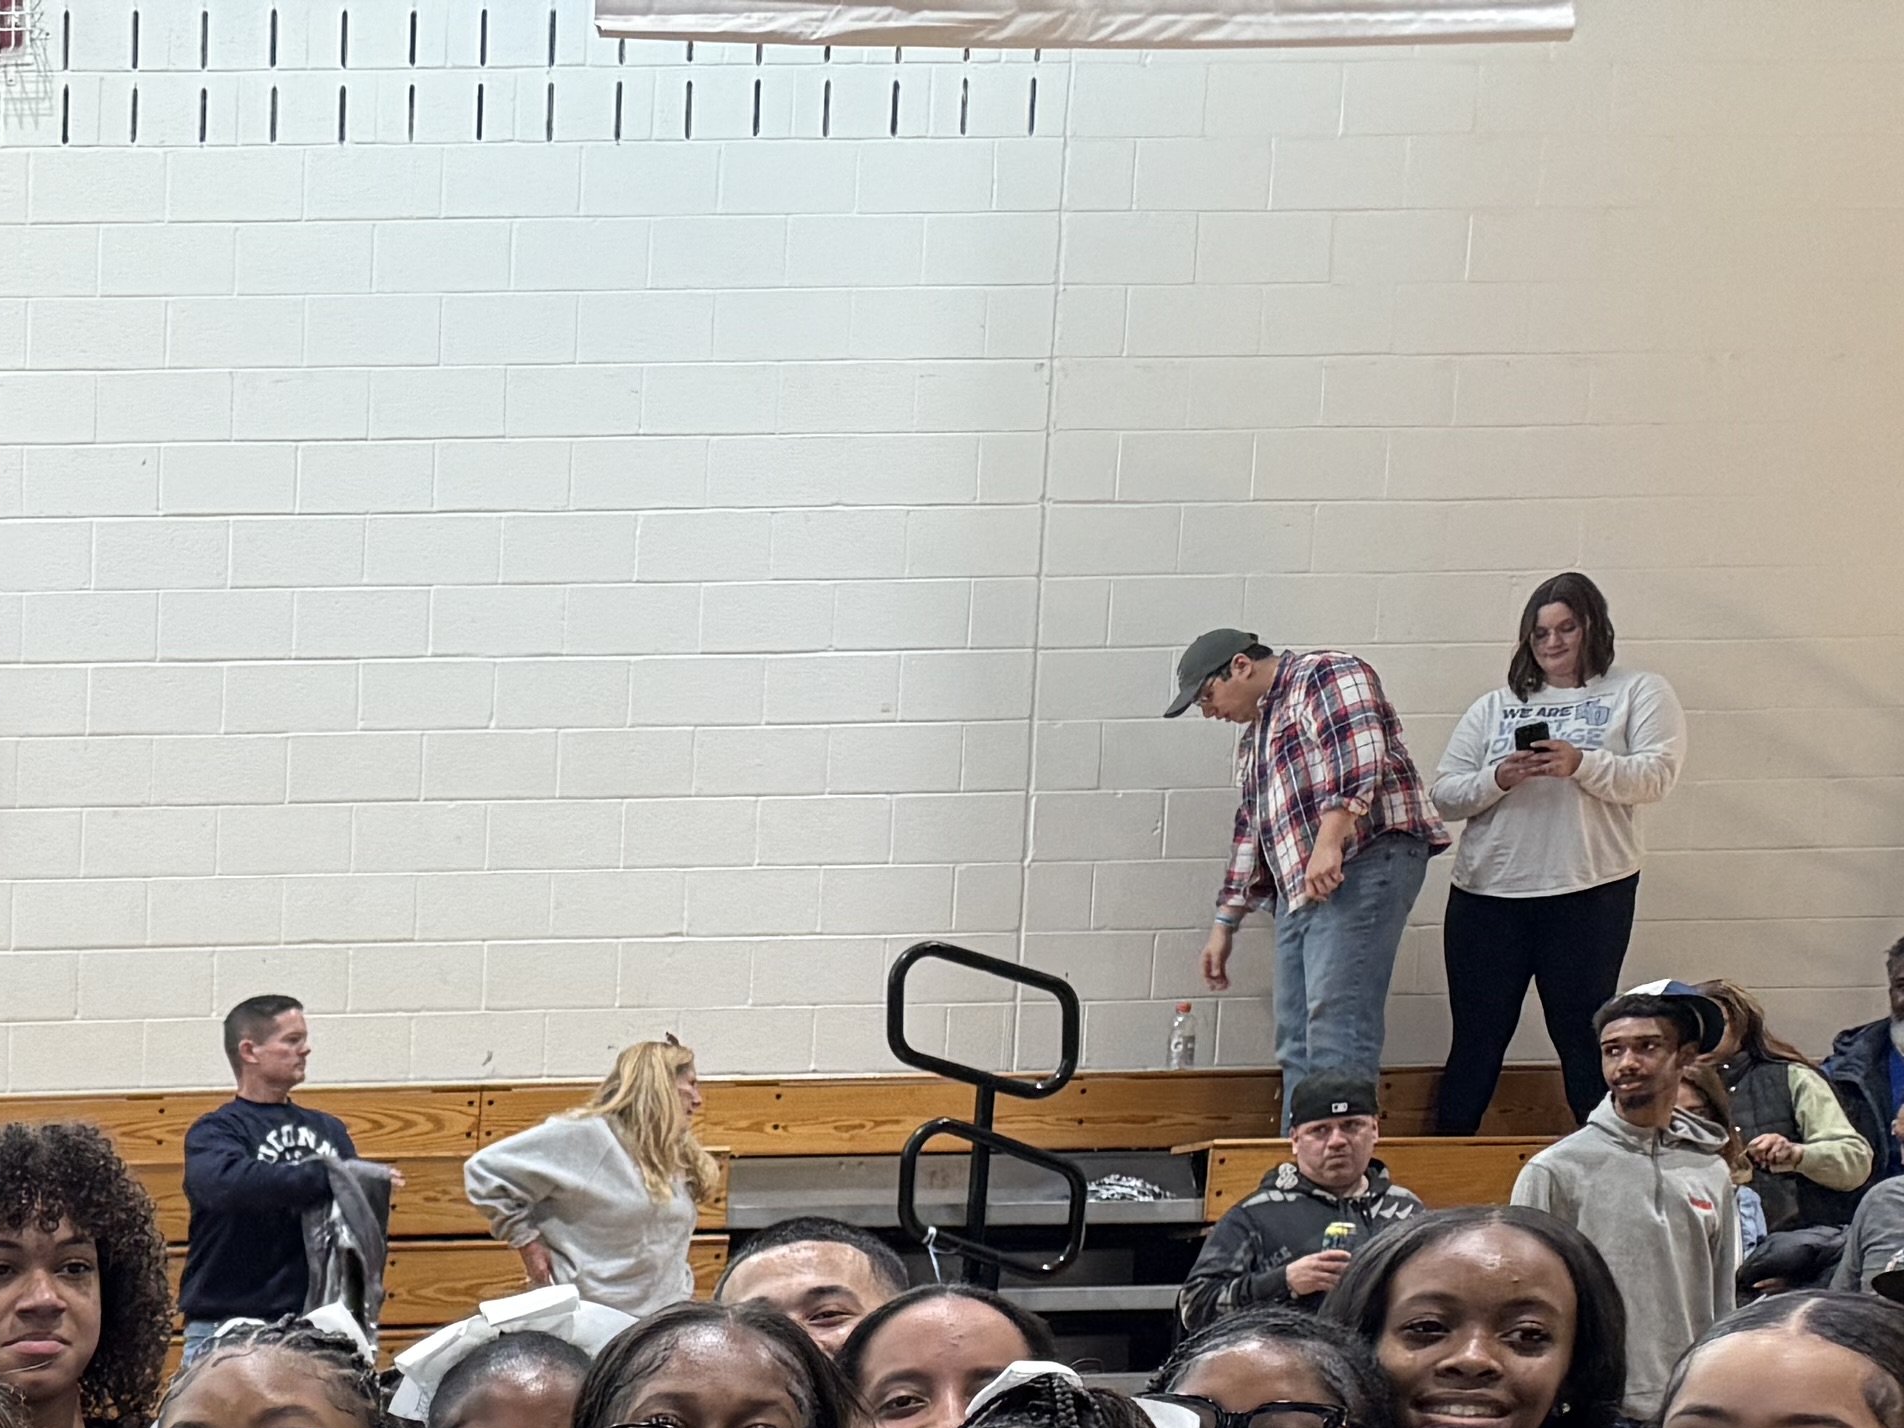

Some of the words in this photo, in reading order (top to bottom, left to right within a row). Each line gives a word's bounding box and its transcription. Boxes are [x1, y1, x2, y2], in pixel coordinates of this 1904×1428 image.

[1503, 707, 1532, 720] WE
[1536, 705, 1574, 718] ARE
[257, 1123, 339, 1165] UCONN
